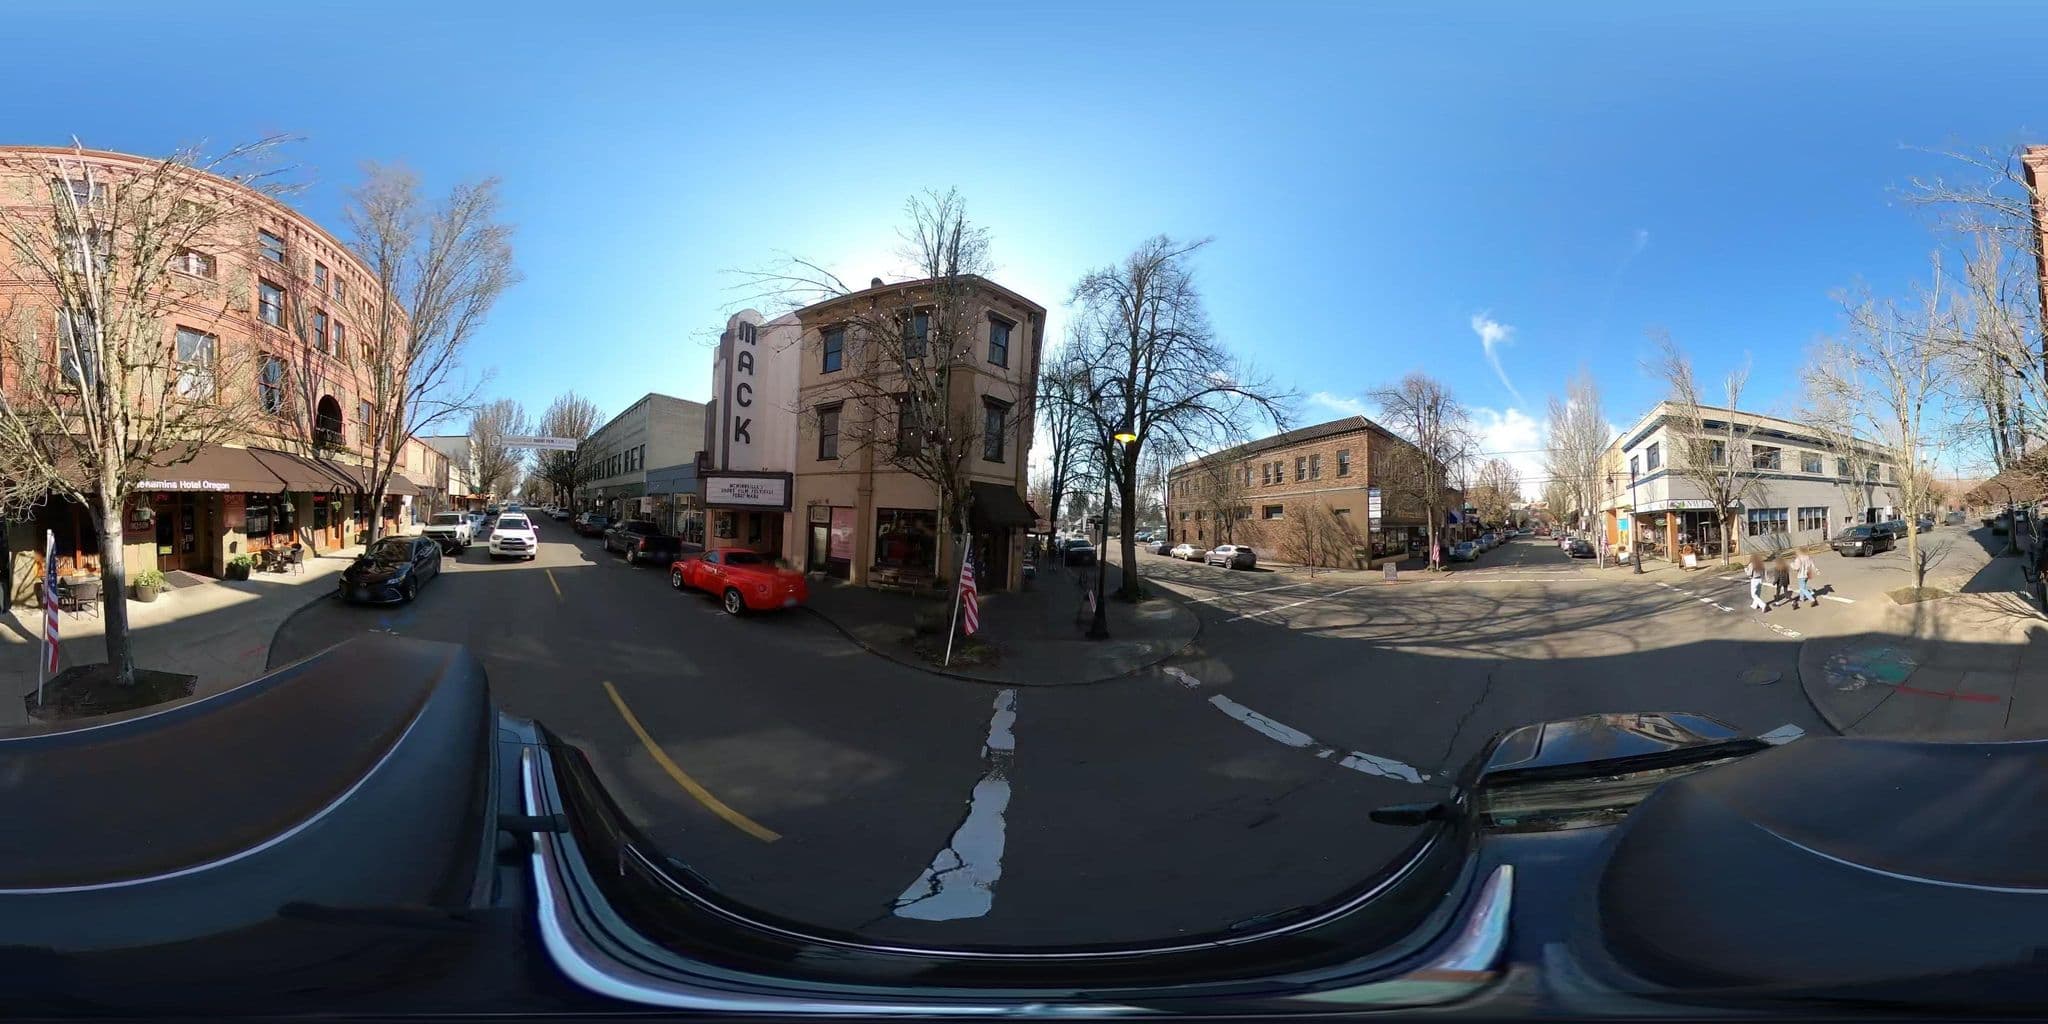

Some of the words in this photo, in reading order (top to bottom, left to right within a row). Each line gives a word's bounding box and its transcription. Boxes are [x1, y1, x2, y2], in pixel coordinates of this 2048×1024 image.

[734, 320, 757, 444] MACK
[179, 480, 202, 489] Hotel
[202, 480, 230, 491] Oregon
